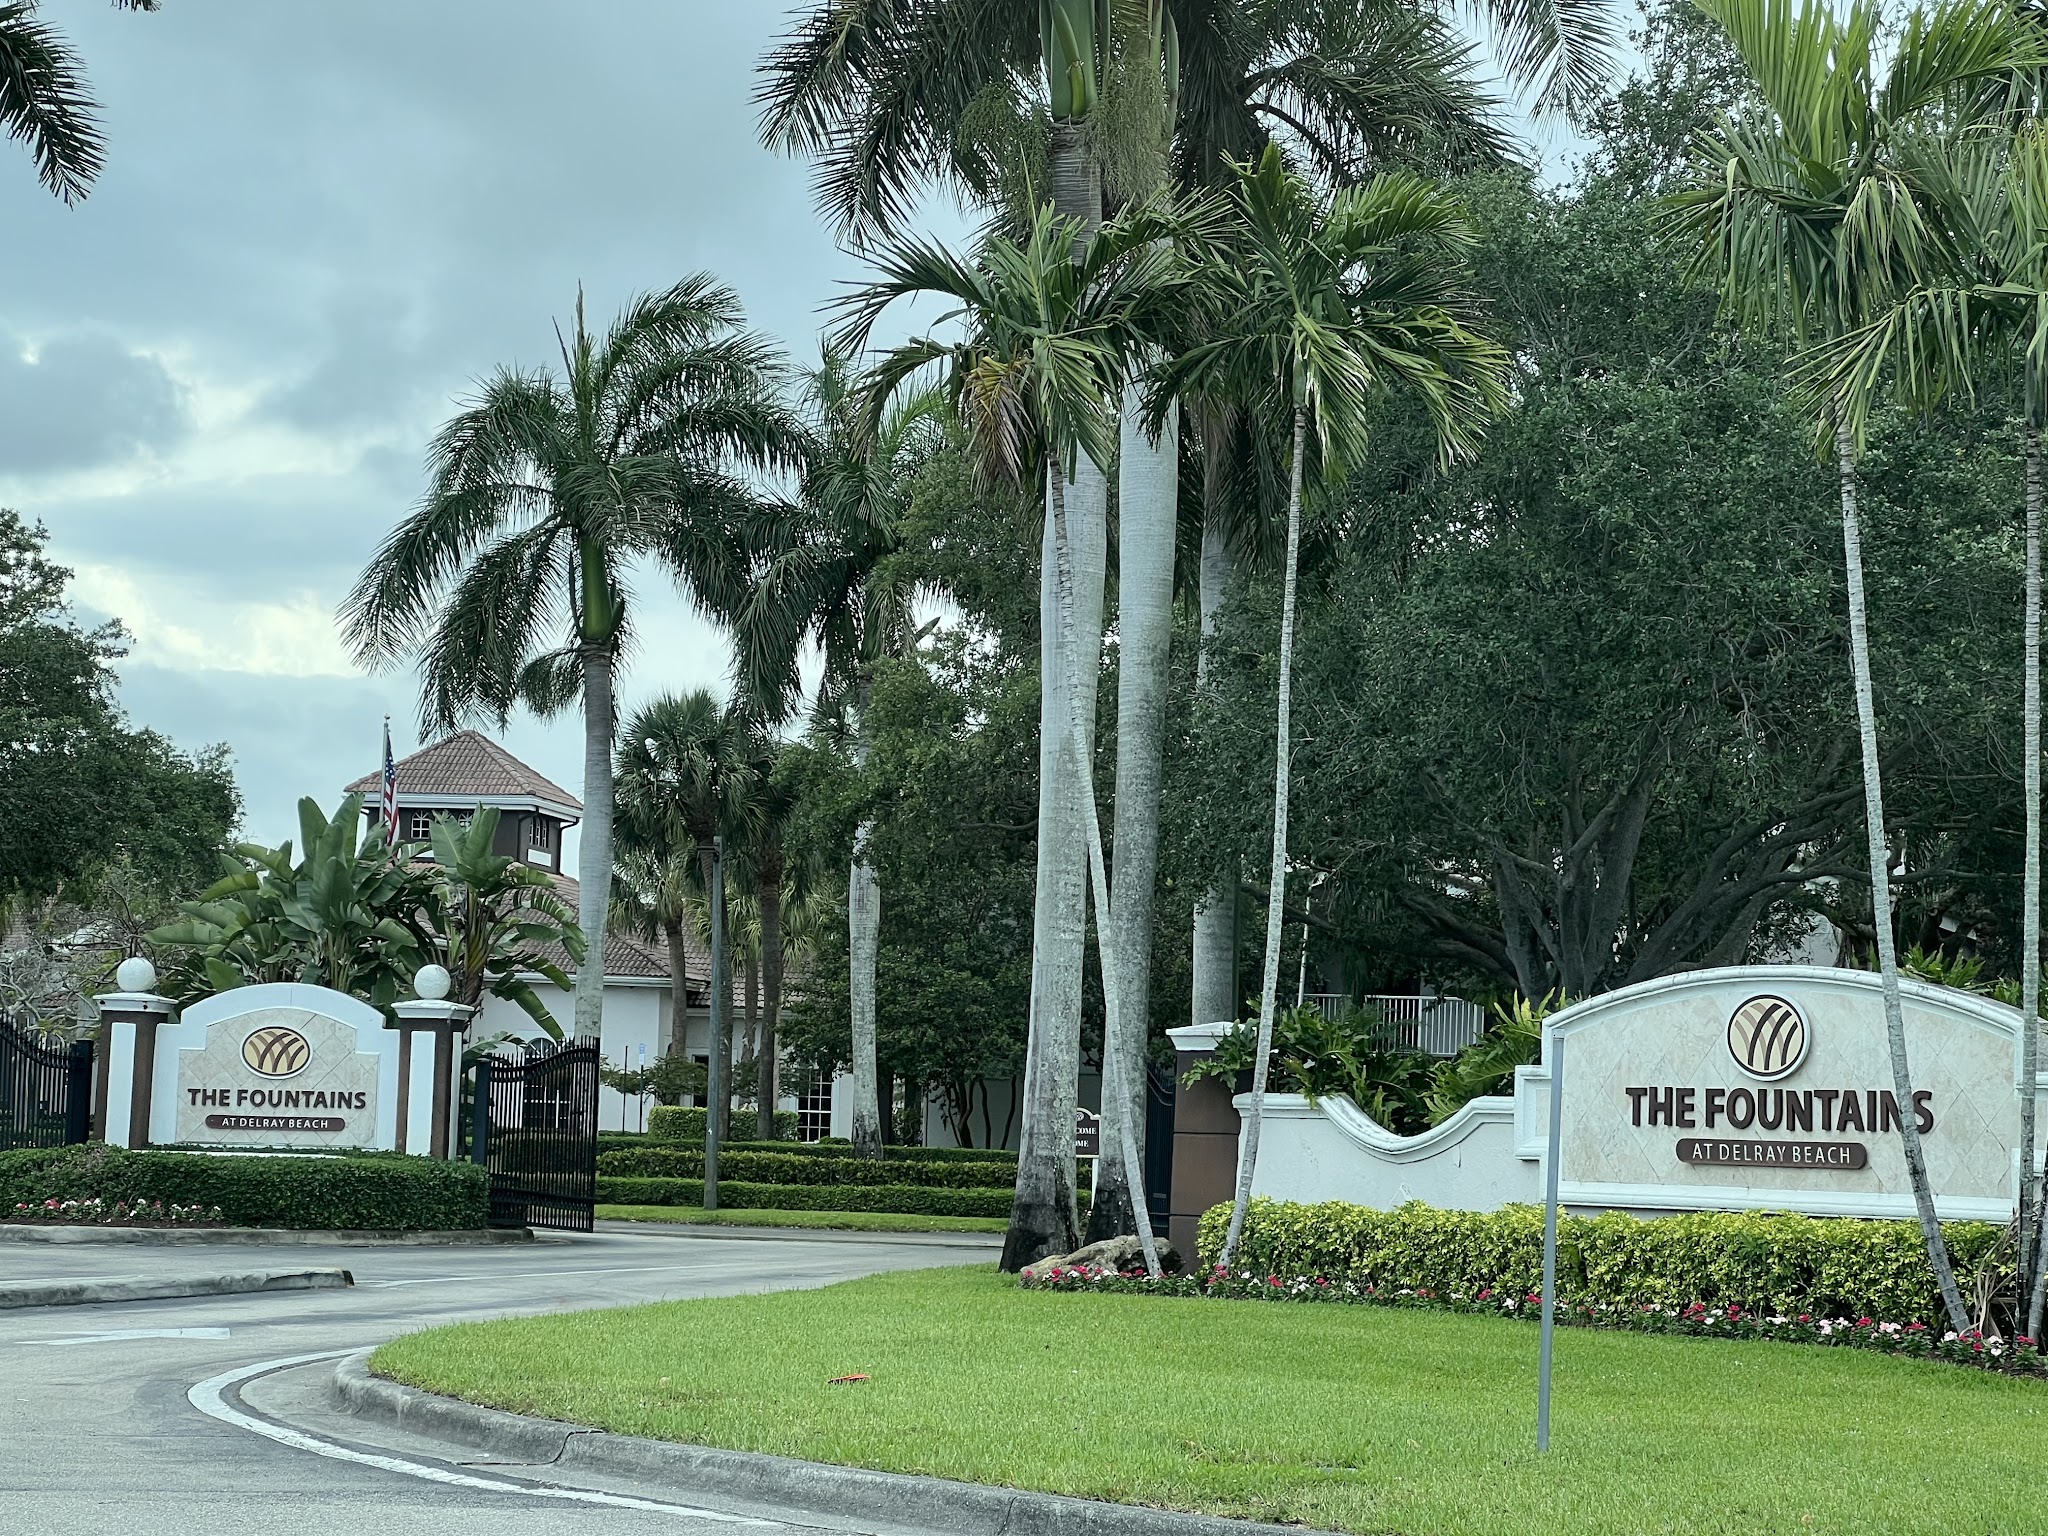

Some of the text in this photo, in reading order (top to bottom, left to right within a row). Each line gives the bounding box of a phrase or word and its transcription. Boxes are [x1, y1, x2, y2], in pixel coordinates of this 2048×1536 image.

[187, 1088, 367, 1110] THE FOUNTAINS
[1625, 1086, 1935, 1135] THE FOUNTAINS
[221, 1117, 328, 1129] AT DELRAY BEACH
[1692, 1142, 1850, 1164] AT DELRAY BEACH
